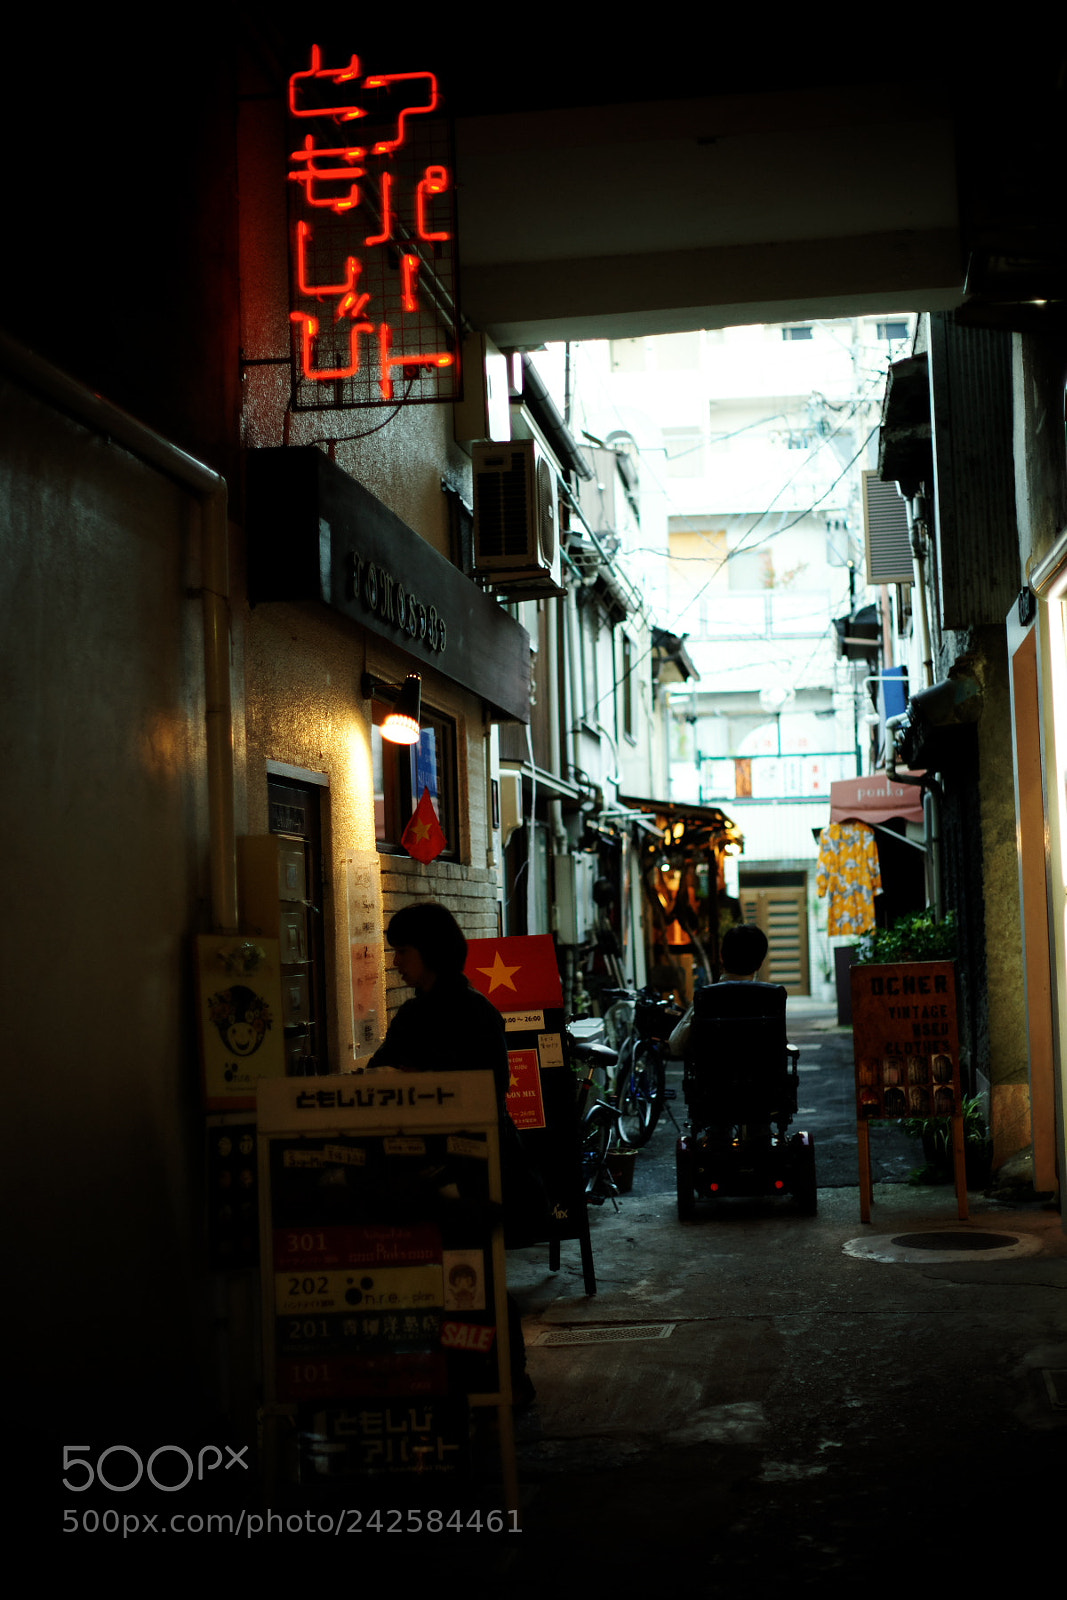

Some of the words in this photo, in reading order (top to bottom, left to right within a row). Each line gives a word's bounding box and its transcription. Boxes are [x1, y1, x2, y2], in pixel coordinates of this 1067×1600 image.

[288, 43, 373, 380] ともしび
[362, 70, 453, 400] アパート
[889, 1005, 948, 1019] VINTAGE
[912, 1022, 949, 1036] USED
[886, 1040, 950, 1055] CLOTHES
[296, 1087, 455, 1110] ともしびアパート
[286, 1231, 328, 1254] 301
[288, 1275, 330, 1297] 202
[288, 1319, 331, 1340] 201
[440, 1323, 491, 1351] SALE
[290, 1363, 332, 1384] 101
[333, 1404, 433, 1436] ともしび
[360, 1435, 460, 1463] アパート
